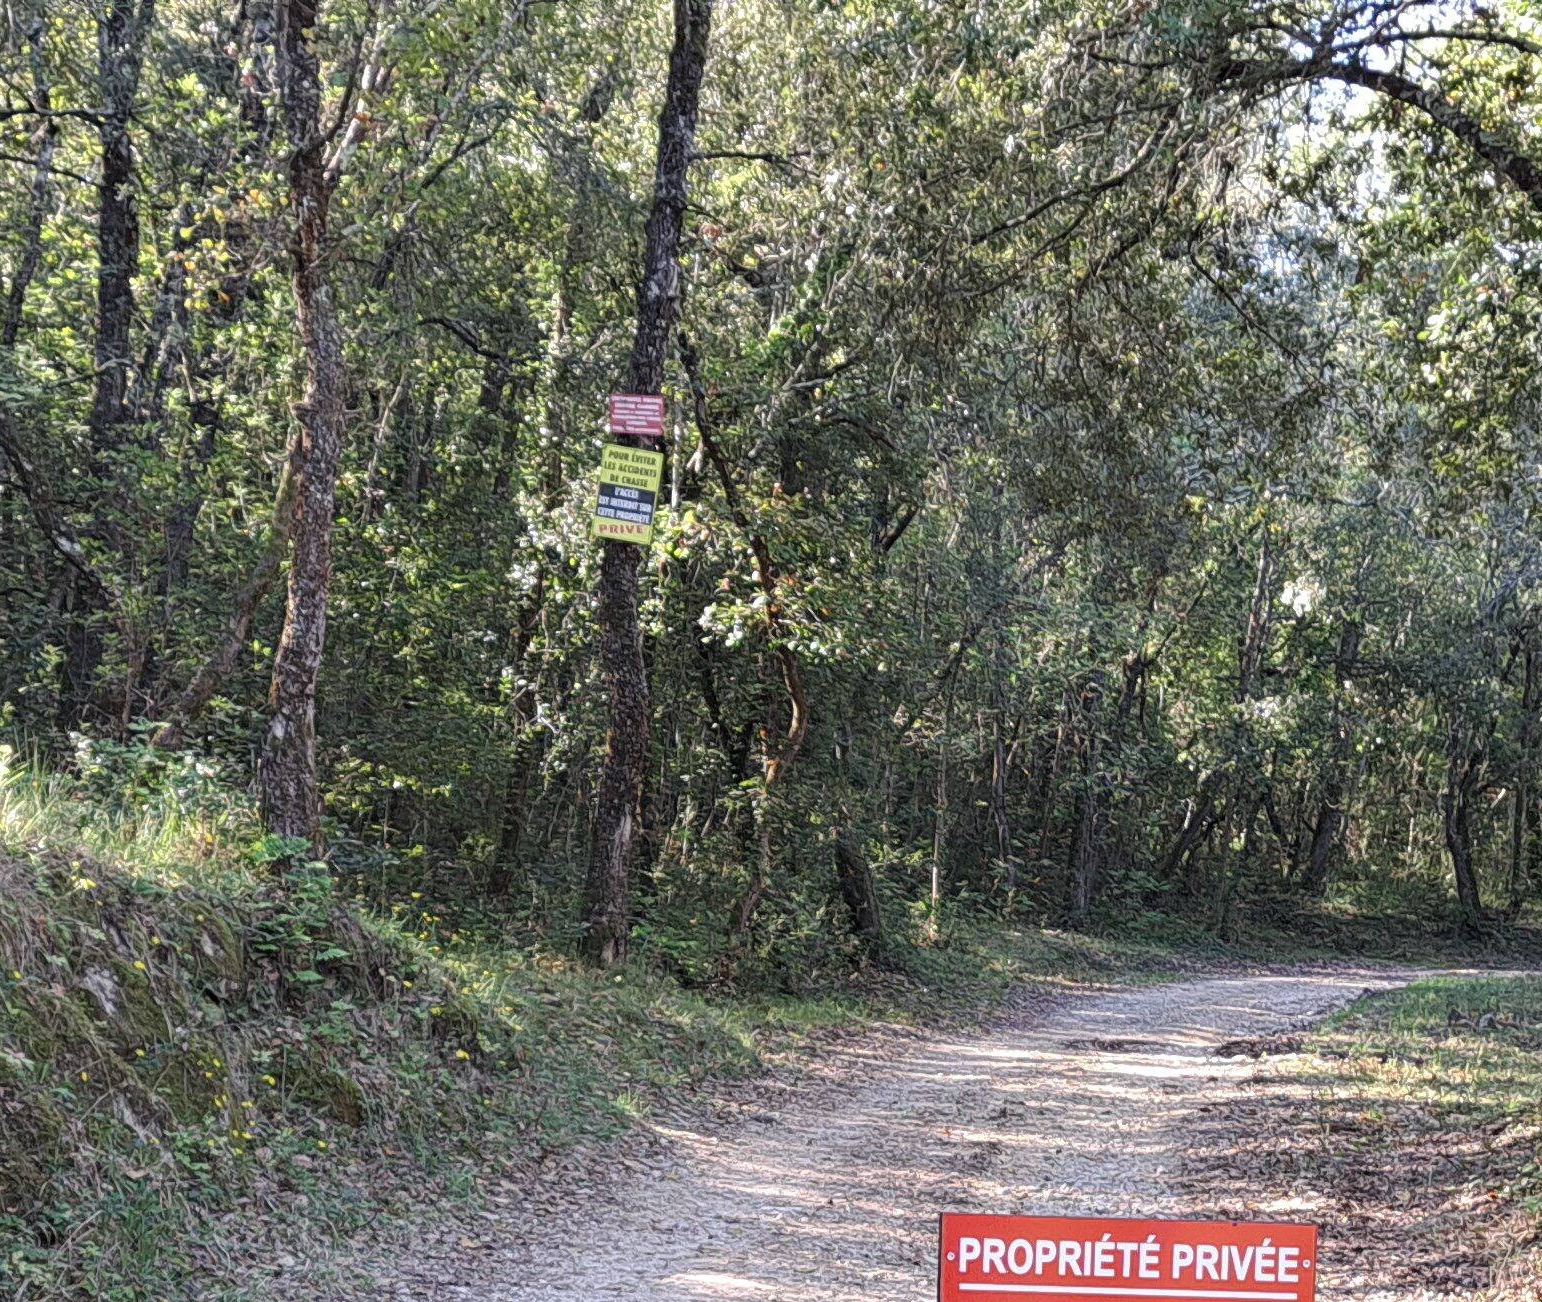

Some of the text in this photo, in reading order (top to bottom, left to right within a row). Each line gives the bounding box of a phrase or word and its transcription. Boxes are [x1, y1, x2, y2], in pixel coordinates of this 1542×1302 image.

[608, 449, 630, 461] POUR
[604, 460, 657, 478] LES ACCIDENTS
[610, 473, 648, 488] DE CHASSE
[959, 1234, 1299, 1282] PROPRIÉTÉ PRIVÉE
